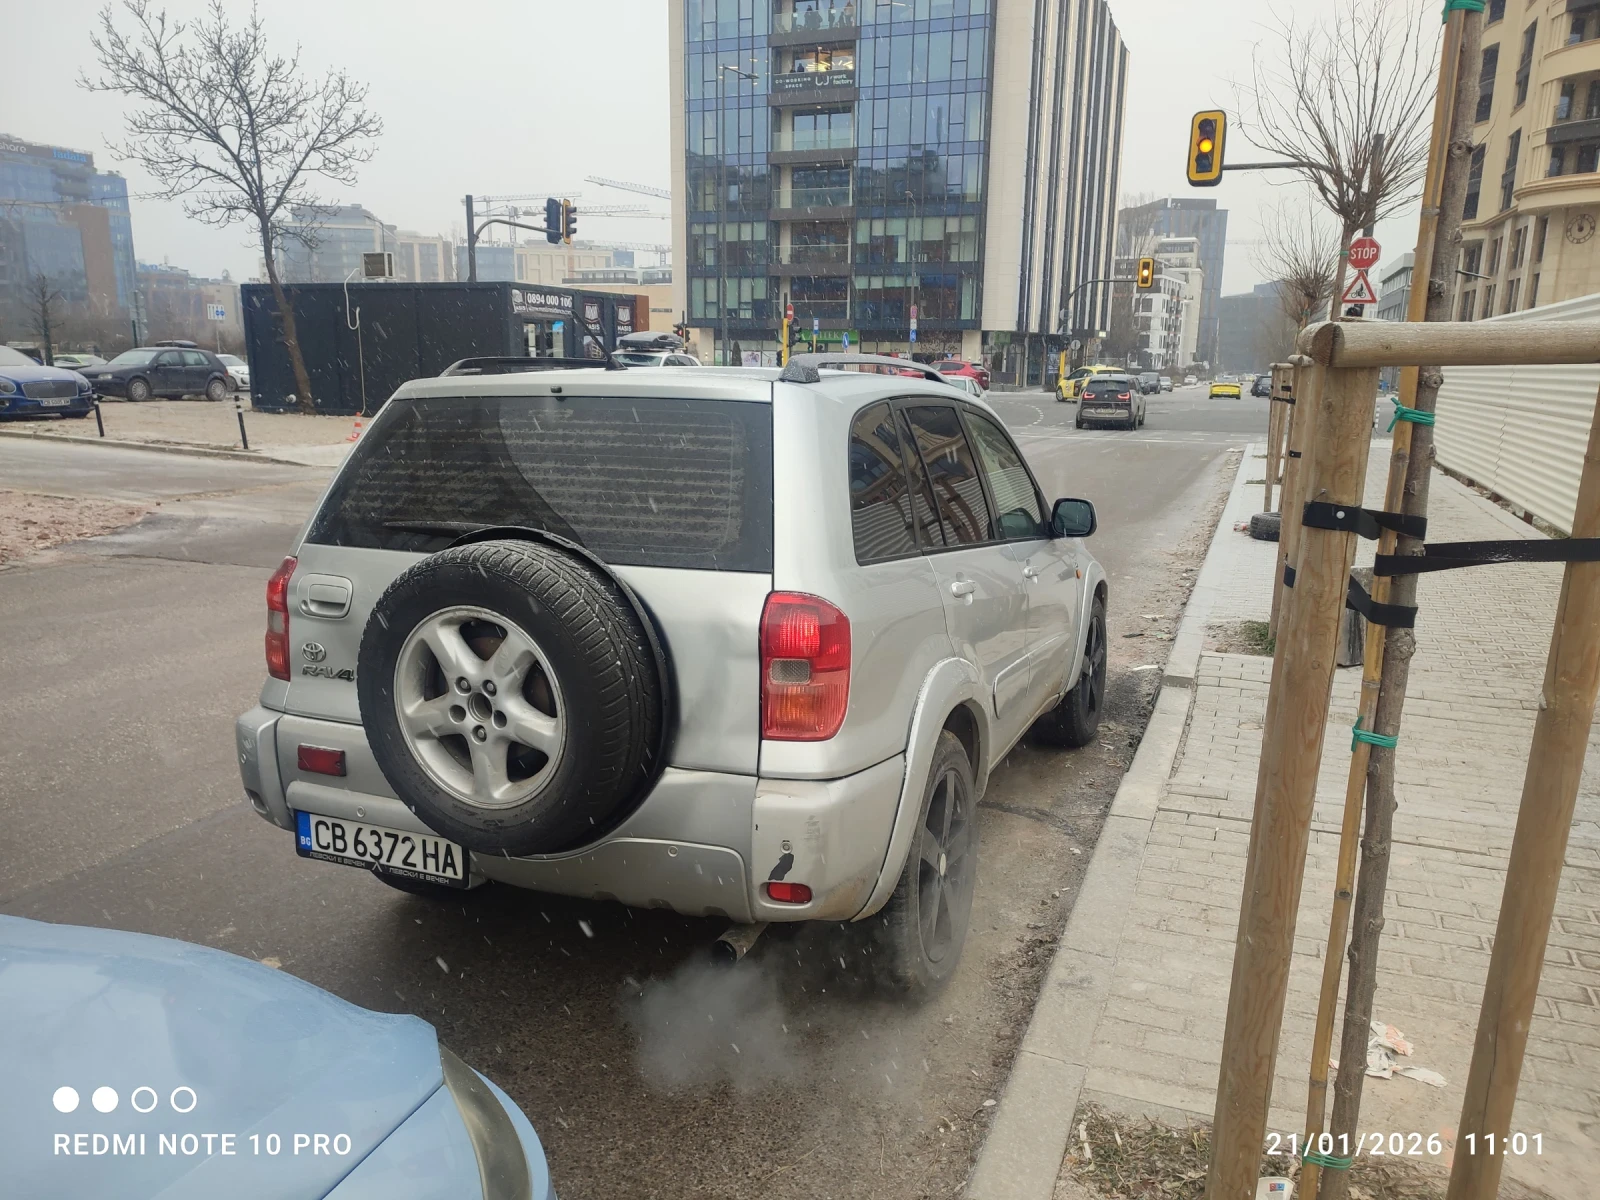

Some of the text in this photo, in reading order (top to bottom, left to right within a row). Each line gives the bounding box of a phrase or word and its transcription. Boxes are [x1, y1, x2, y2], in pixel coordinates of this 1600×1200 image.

[1350, 247, 1377, 260] STOP
[527, 293, 545, 305] 0894
[546, 295, 559, 306] 000
[301, 664, 355, 682] RAV4
[300, 835, 311, 846] BG
[315, 820, 348, 853] CB
[353, 827, 418, 868] 6372
[343, 858, 366, 868] ВЕЧЕН
[425, 875, 450, 885] ВЕЧЕН
